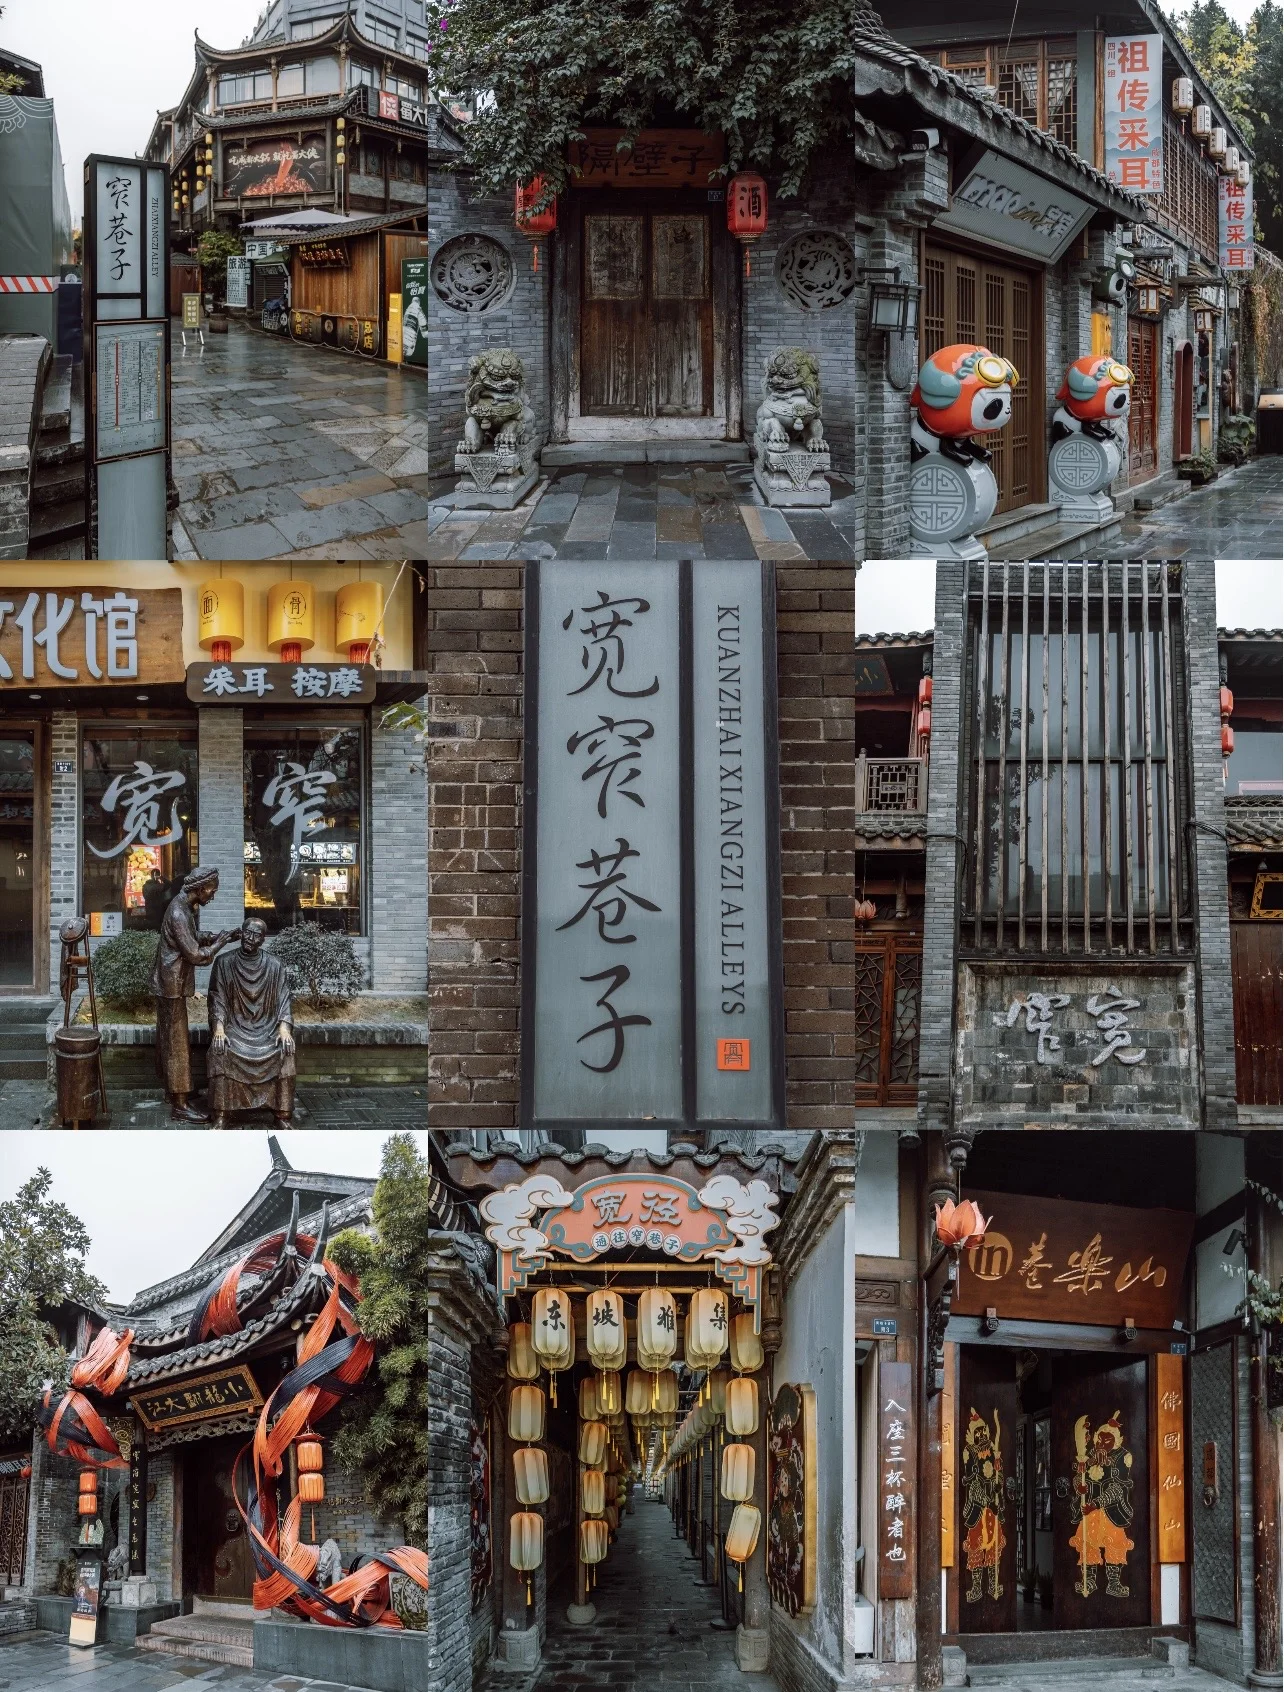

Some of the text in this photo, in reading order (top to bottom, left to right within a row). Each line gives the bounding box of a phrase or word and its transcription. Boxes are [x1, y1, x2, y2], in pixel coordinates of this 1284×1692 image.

[577, 142, 714, 177] 隔壁子
[1117, 40, 1150, 190] 祖传采耳
[104, 176, 133, 281] 窄巷子
[739, 186, 762, 220] 酒
[1226, 179, 1246, 268] 祖传采耳
[151, 251, 159, 278] ALLEY
[228, 257, 247, 270] 旅游
[203, 665, 363, 698] 采耳 按摩
[86, 761, 186, 859] 宽
[262, 762, 337, 886] 窄
[555, 590, 663, 1073] 宽窄巷子
[721, 900, 746, 1016] ALLEYS
[595, 1229, 680, 1251] 通往窄巷子
[541, 1299, 728, 1333] 东坡雅集
[884, 1398, 907, 1562] 入座三杯醉者也
[1161, 1391, 1182, 1532] 佛國仙山
